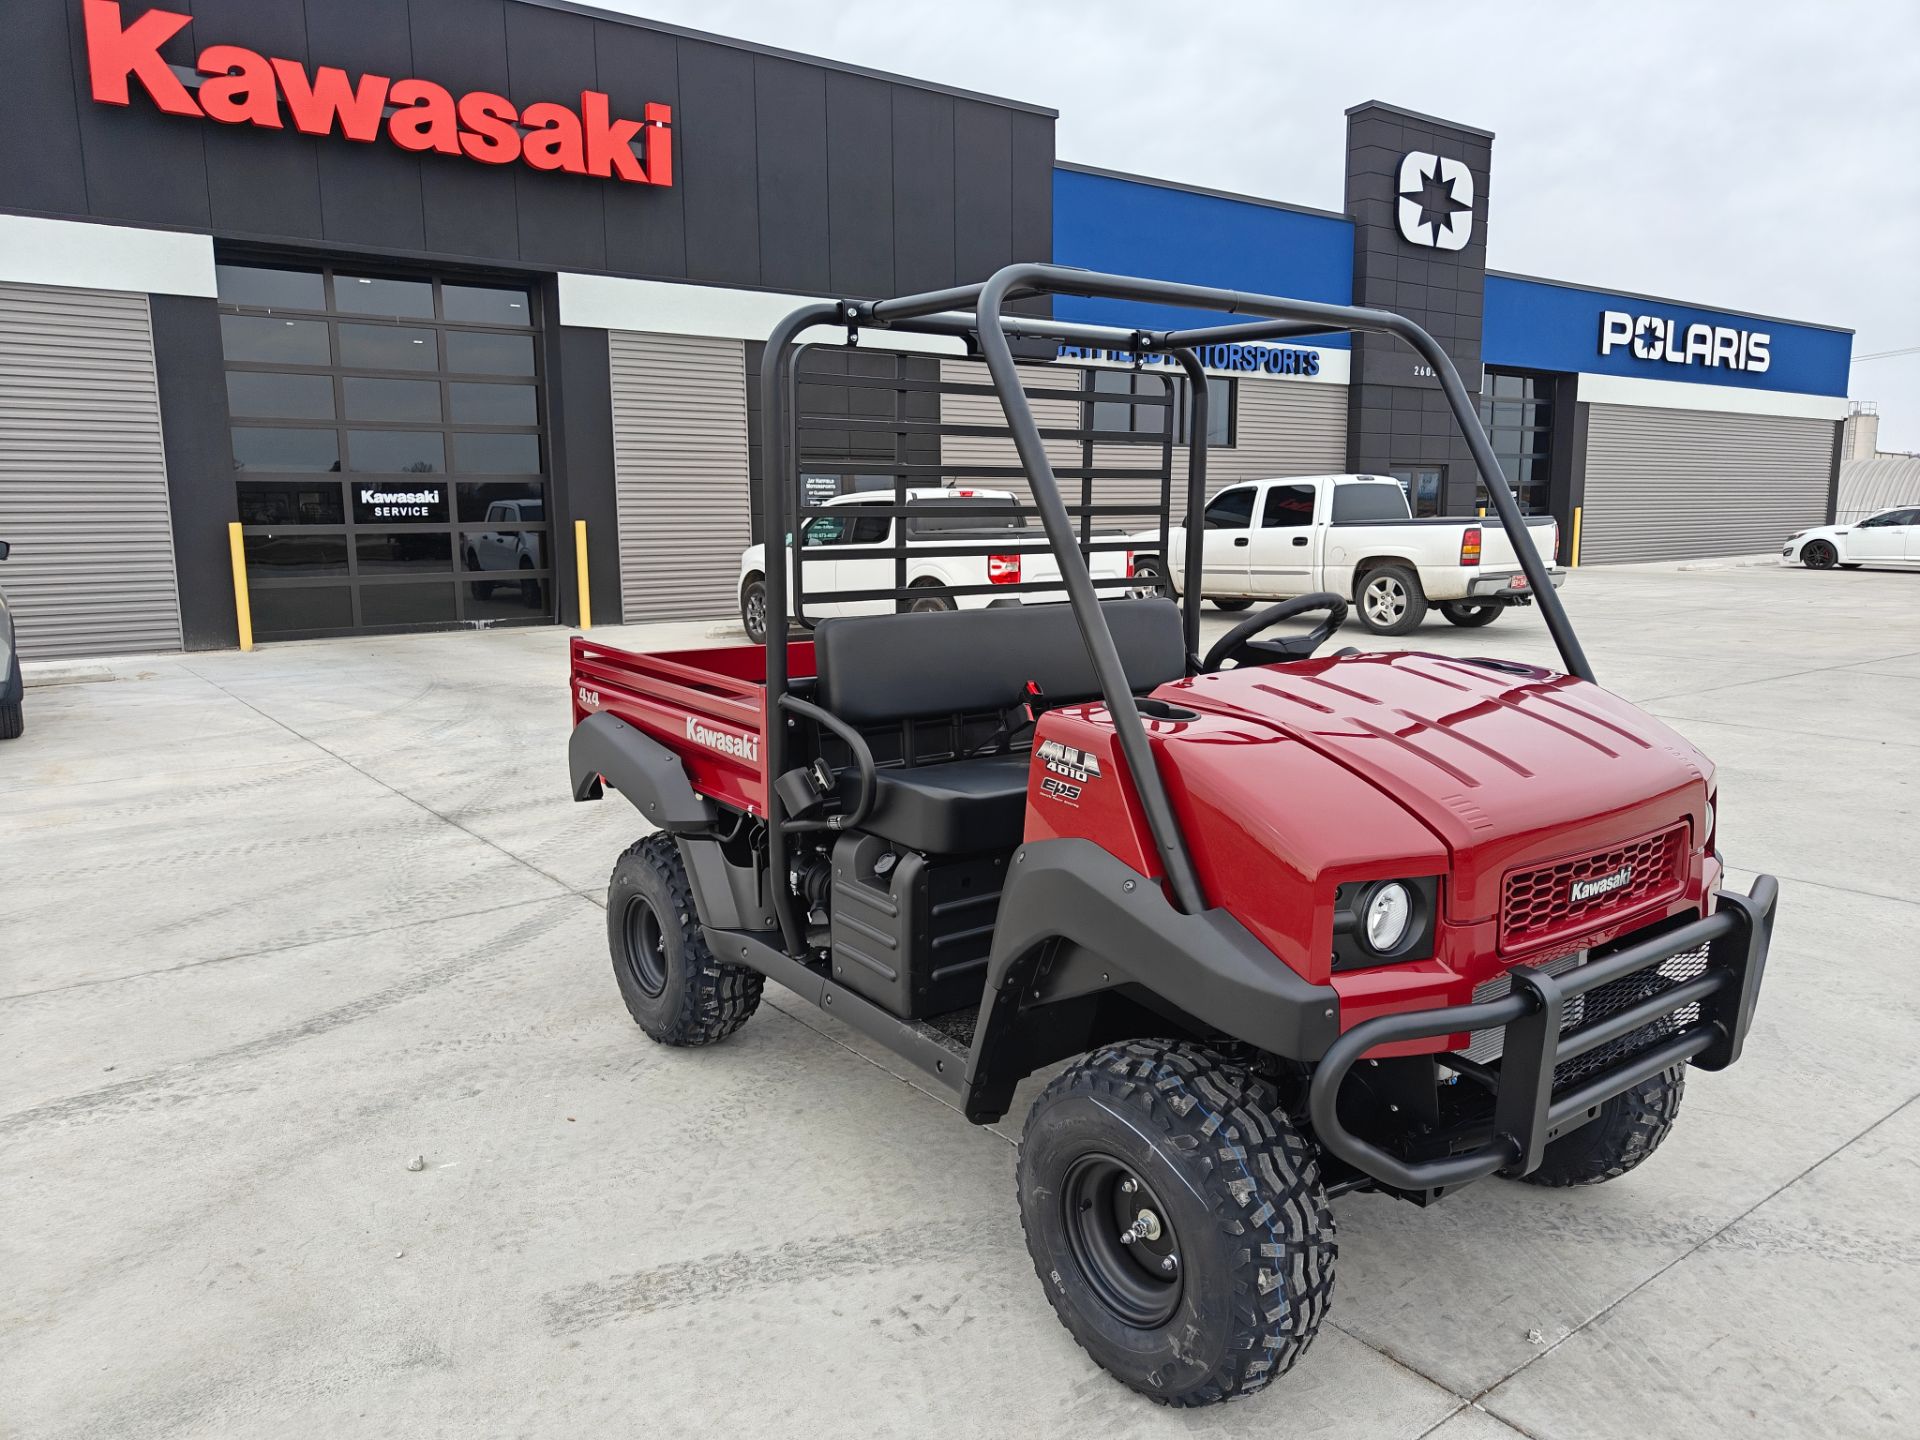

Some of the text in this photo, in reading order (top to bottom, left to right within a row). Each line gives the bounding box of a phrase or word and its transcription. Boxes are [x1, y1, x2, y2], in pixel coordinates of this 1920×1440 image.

[83, 0, 673, 187] Kawasaki
[1600, 310, 1771, 373] POLARIS
[361, 490, 440, 504] Kawasaki
[374, 507, 429, 517] SERVICE
[578, 687, 600, 707] 4x4
[686, 716, 758, 762] Kawasaki
[1036, 740, 1103, 779] MULE
[1046, 761, 1088, 783] 4010
[1571, 866, 1633, 902] Kawasaki
